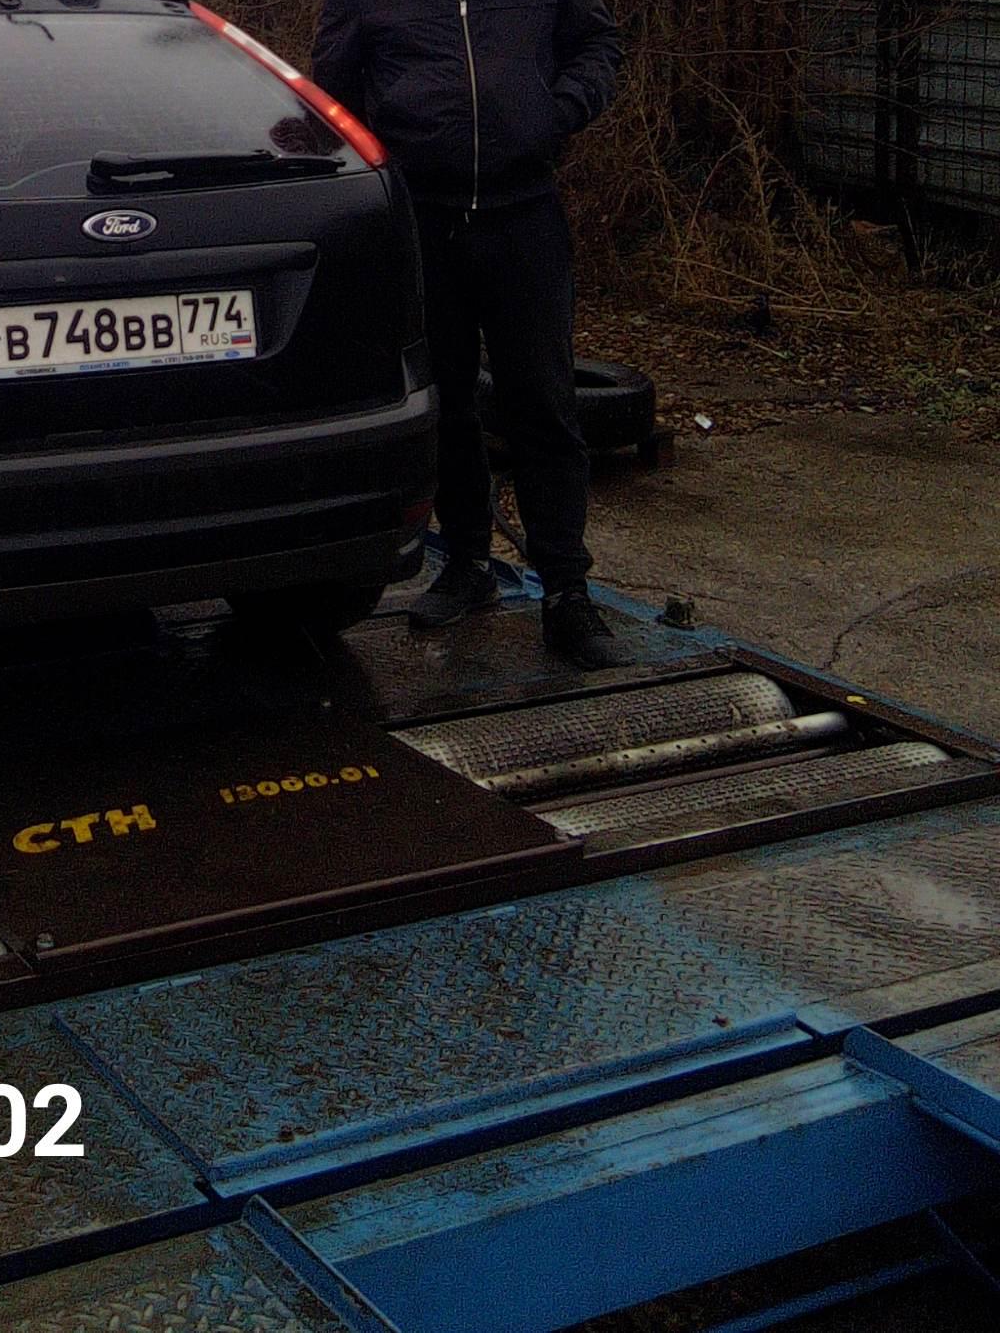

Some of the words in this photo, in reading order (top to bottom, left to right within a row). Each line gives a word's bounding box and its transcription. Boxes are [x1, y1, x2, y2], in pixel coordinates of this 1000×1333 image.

[102, 215, 141, 235] Ford
[5, 307, 174, 361] В748ВВ
[181, 294, 243, 334] 774
[200, 331, 230, 347] RUS
